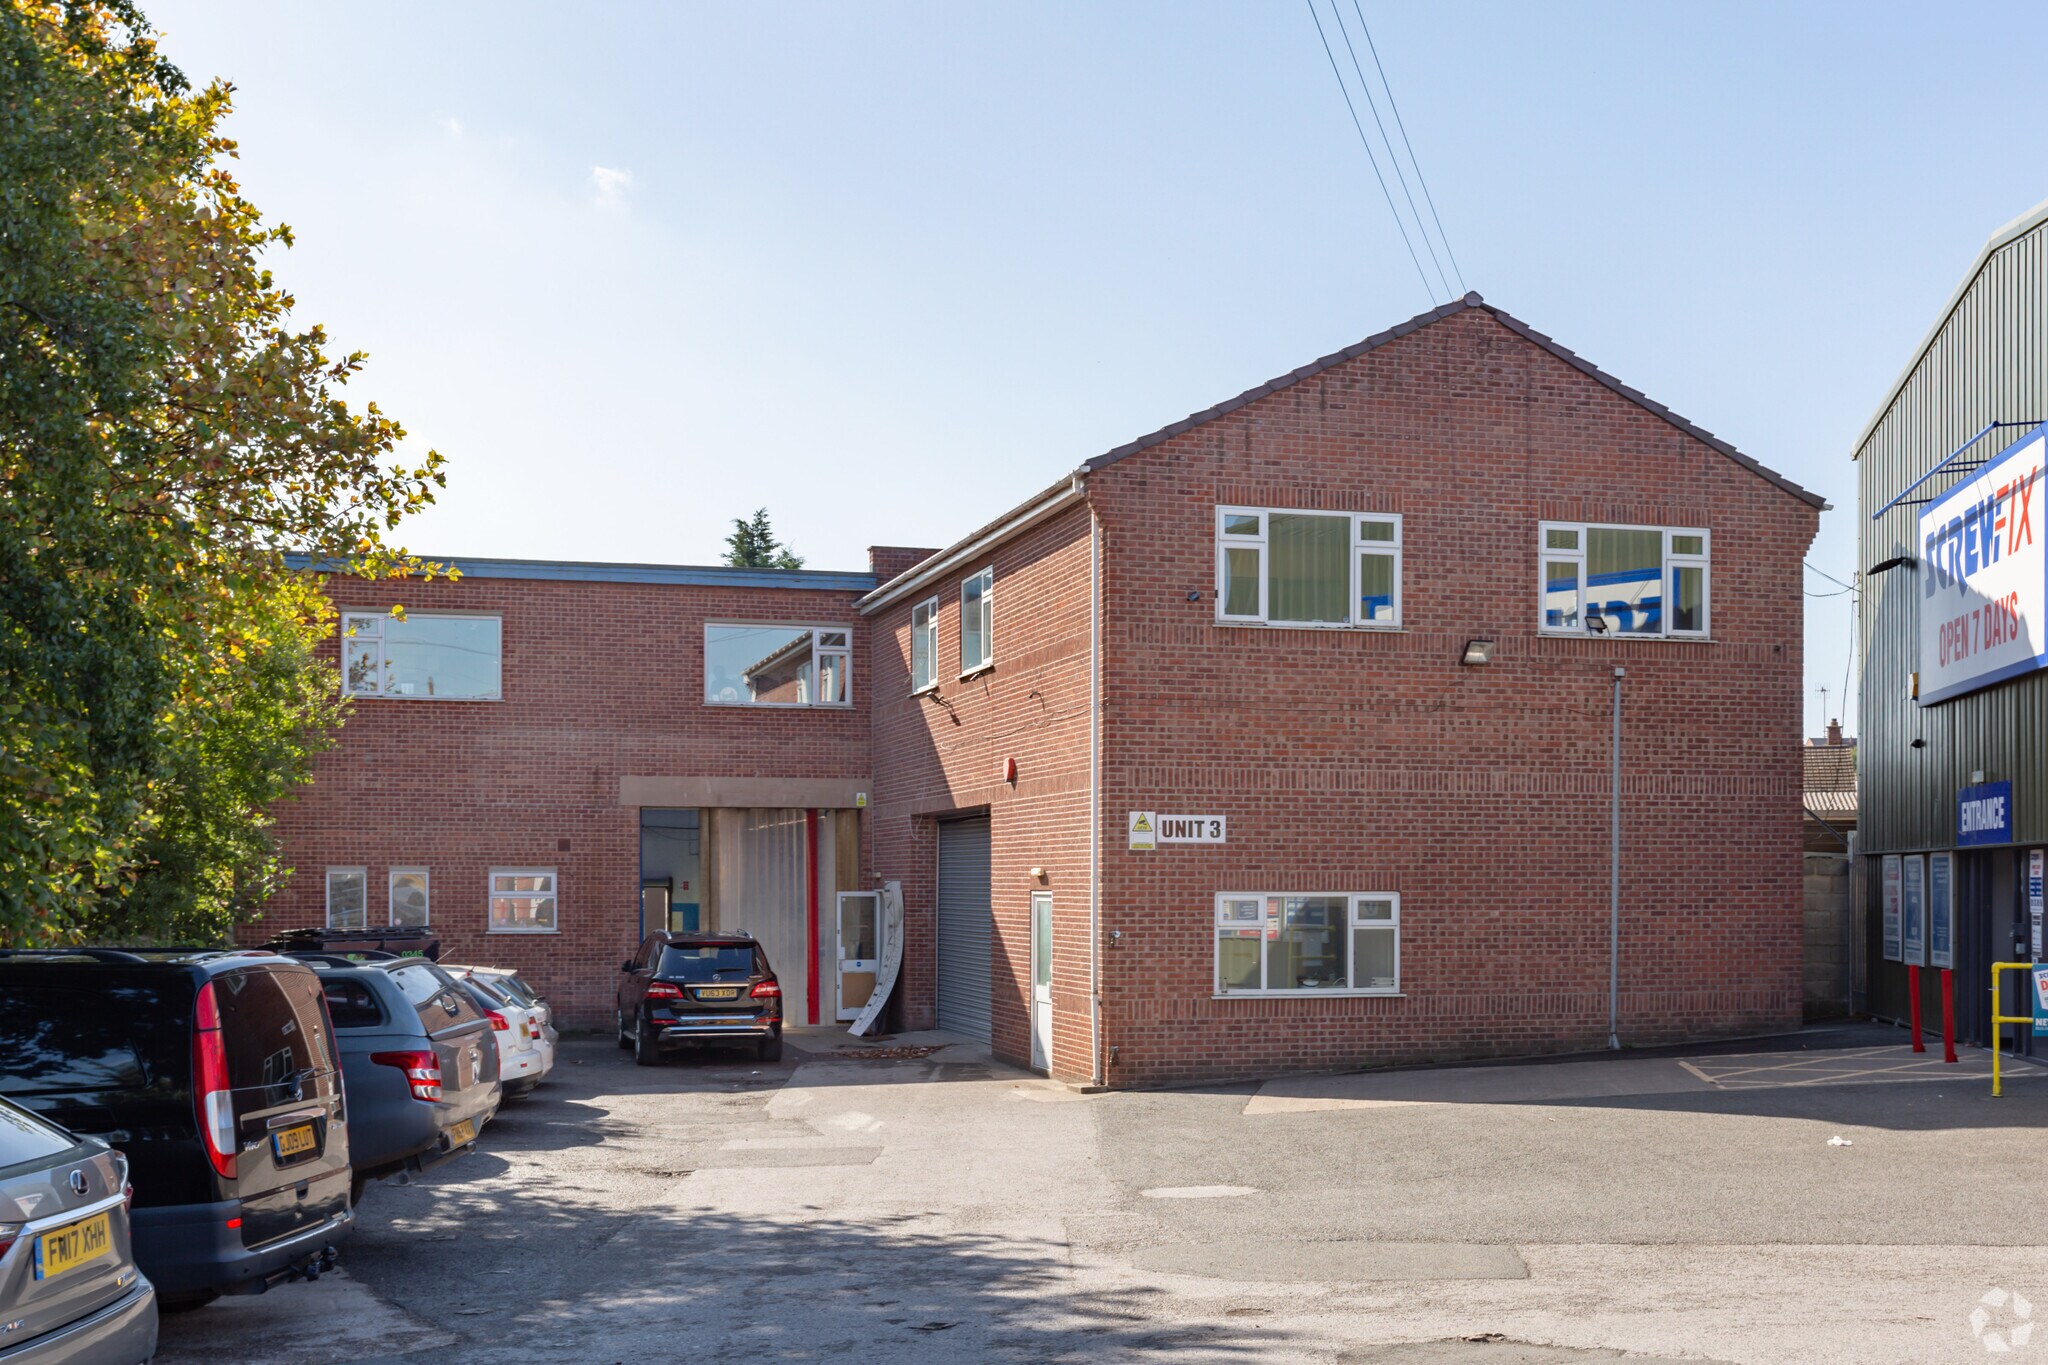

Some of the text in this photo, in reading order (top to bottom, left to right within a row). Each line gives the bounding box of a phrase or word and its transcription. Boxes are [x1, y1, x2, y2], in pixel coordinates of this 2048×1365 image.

[1925, 465, 2037, 599] SCREWFIX
[1939, 591, 2018, 668] OPEN 7 DAYS
[1162, 820, 1221, 838] UNIT 3
[1961, 796, 2005, 832] ENTRANCE
[48, 1219, 106, 1267] FM17 XHH
